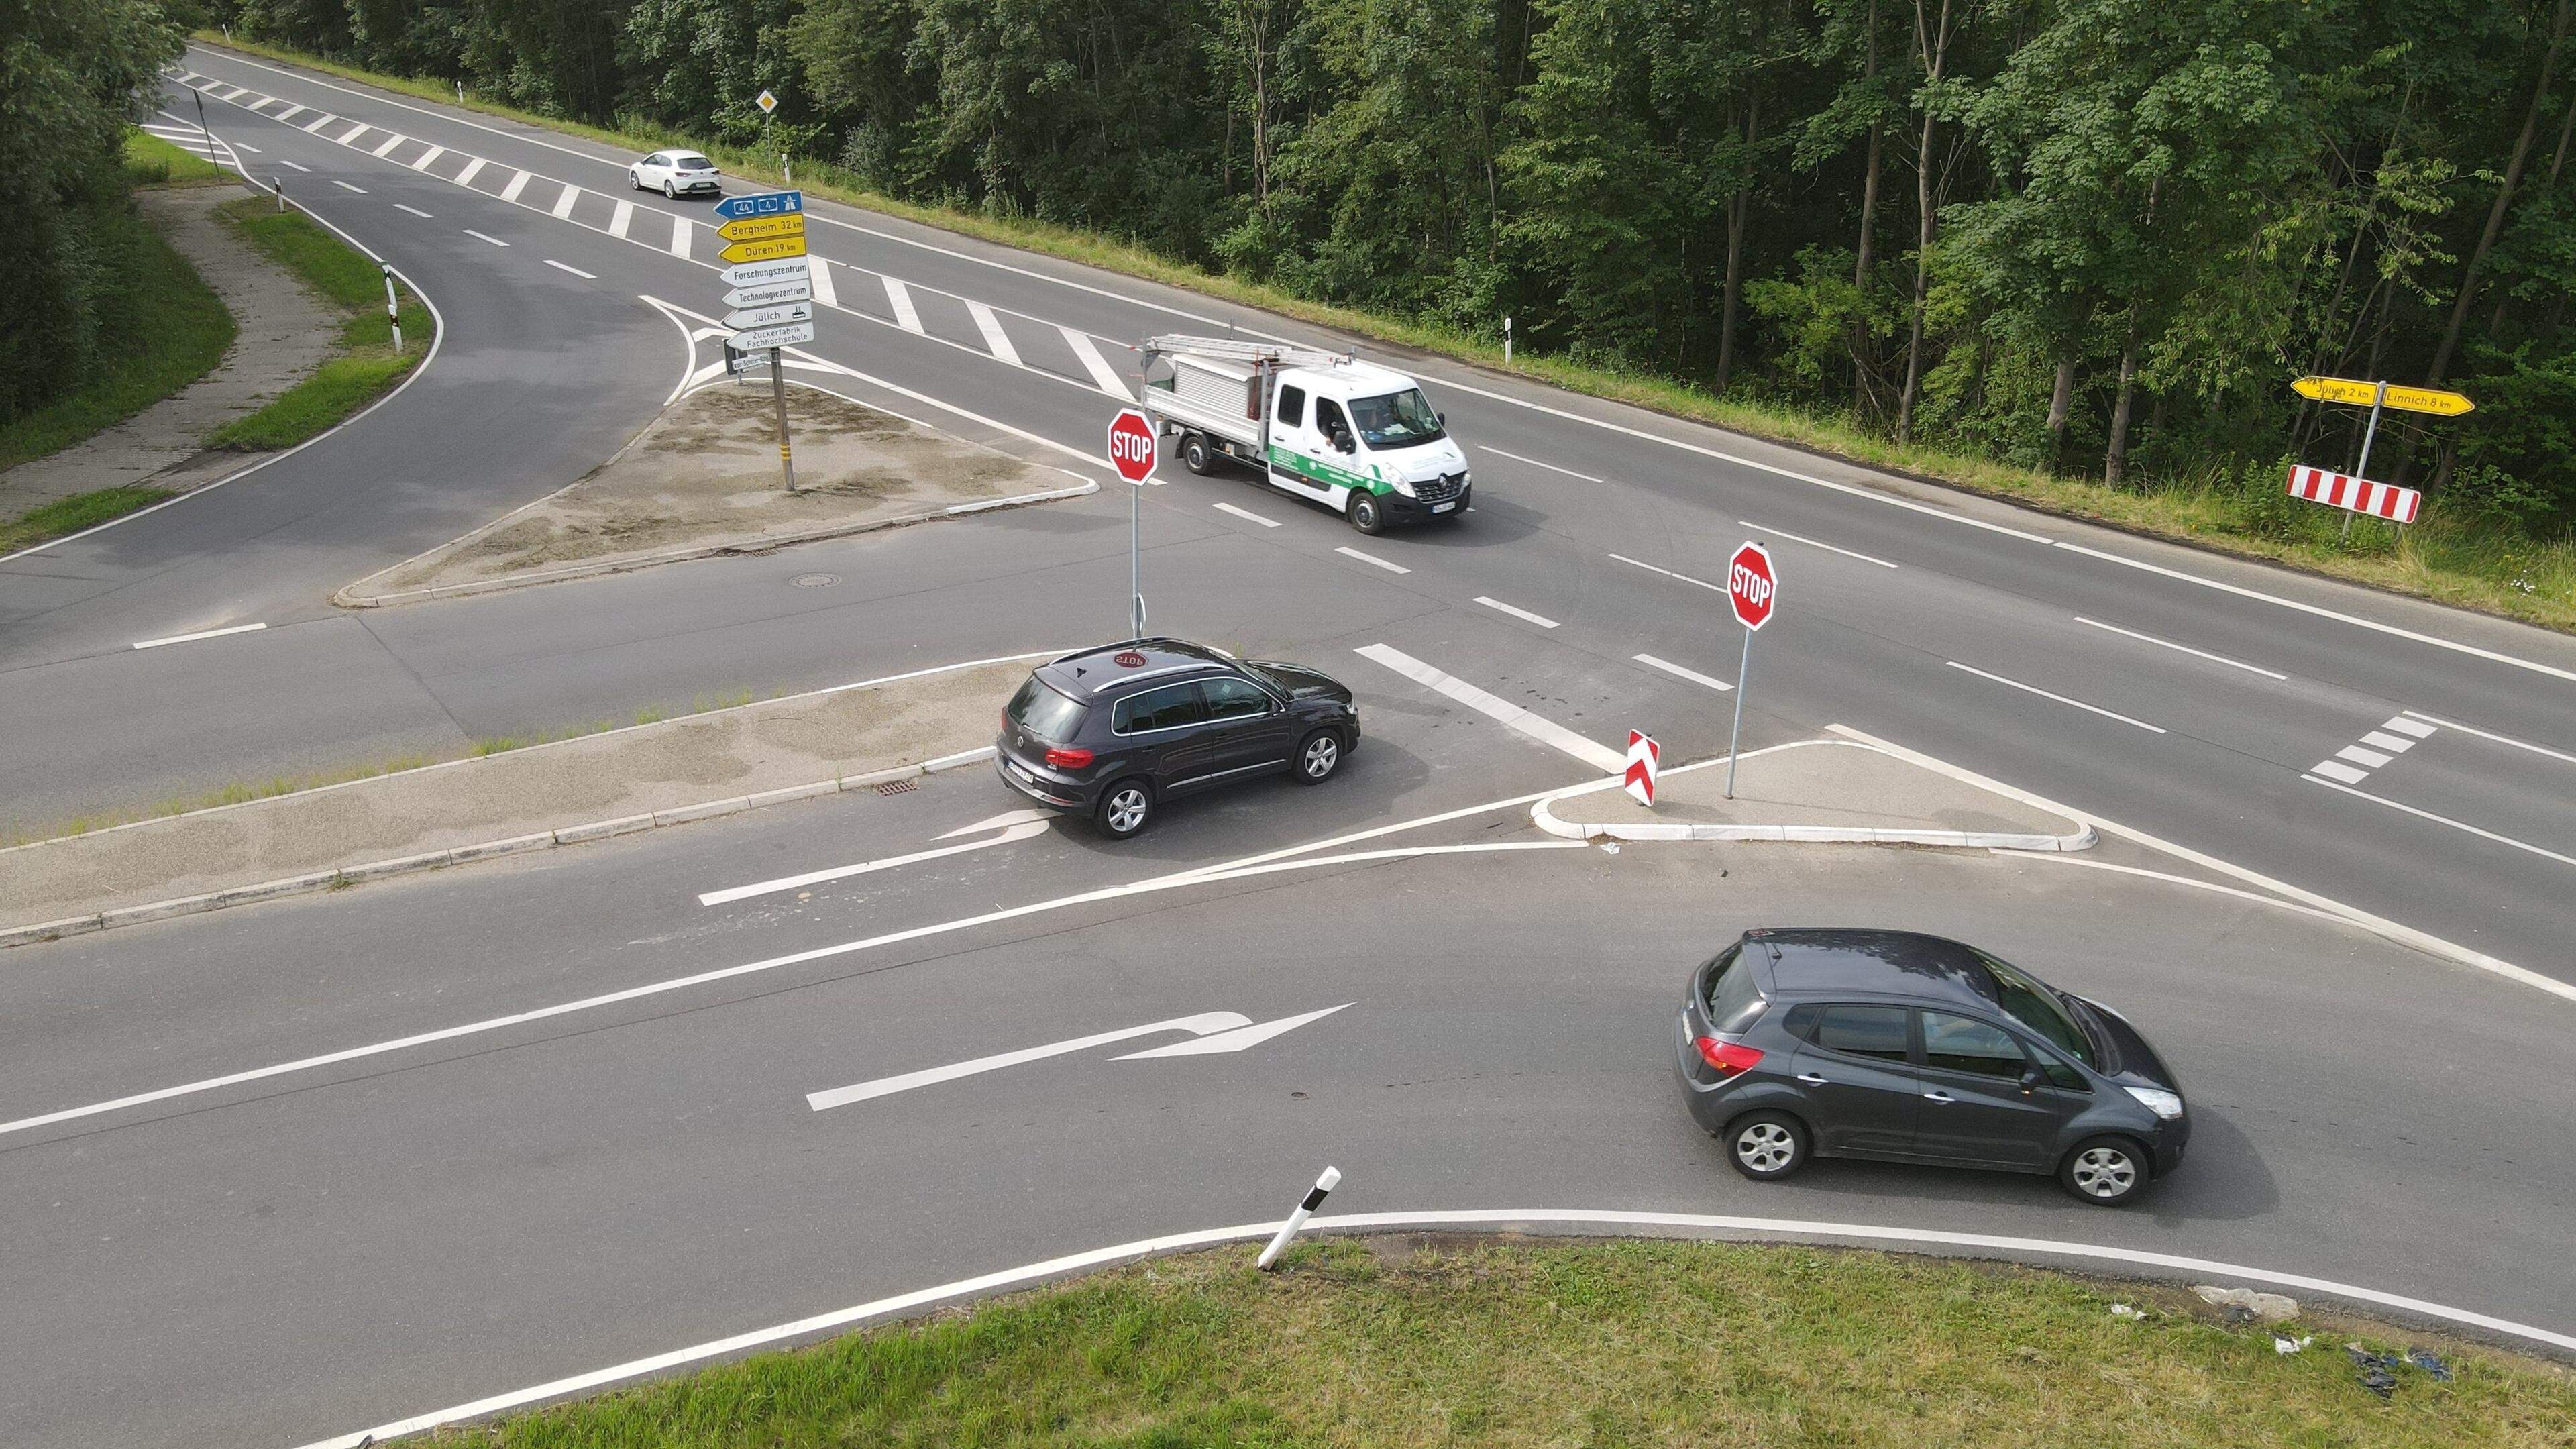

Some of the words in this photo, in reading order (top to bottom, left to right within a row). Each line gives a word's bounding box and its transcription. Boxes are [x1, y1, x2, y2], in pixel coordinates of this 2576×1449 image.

[731, 224, 777, 235] Bergheim
[781, 221, 791, 229] 32
[745, 246, 773, 256] Düren
[776, 244, 784, 252] 19
[734, 265, 807, 280] Forschungszentrum
[739, 288, 806, 301] Technologiezentrum
[753, 311, 780, 322] Jülich
[753, 327, 801, 339] Zuckerfabrik
[747, 333, 808, 348] Fachhochschule
[2349, 388, 2355, 397] 2
[2358, 390, 2369, 398] km
[2387, 392, 2427, 405] Linnich
[2430, 397, 2437, 407] 8
[2439, 400, 2451, 409] km
[1113, 430, 1152, 464] STOP
[1732, 564, 1770, 608] STOP
